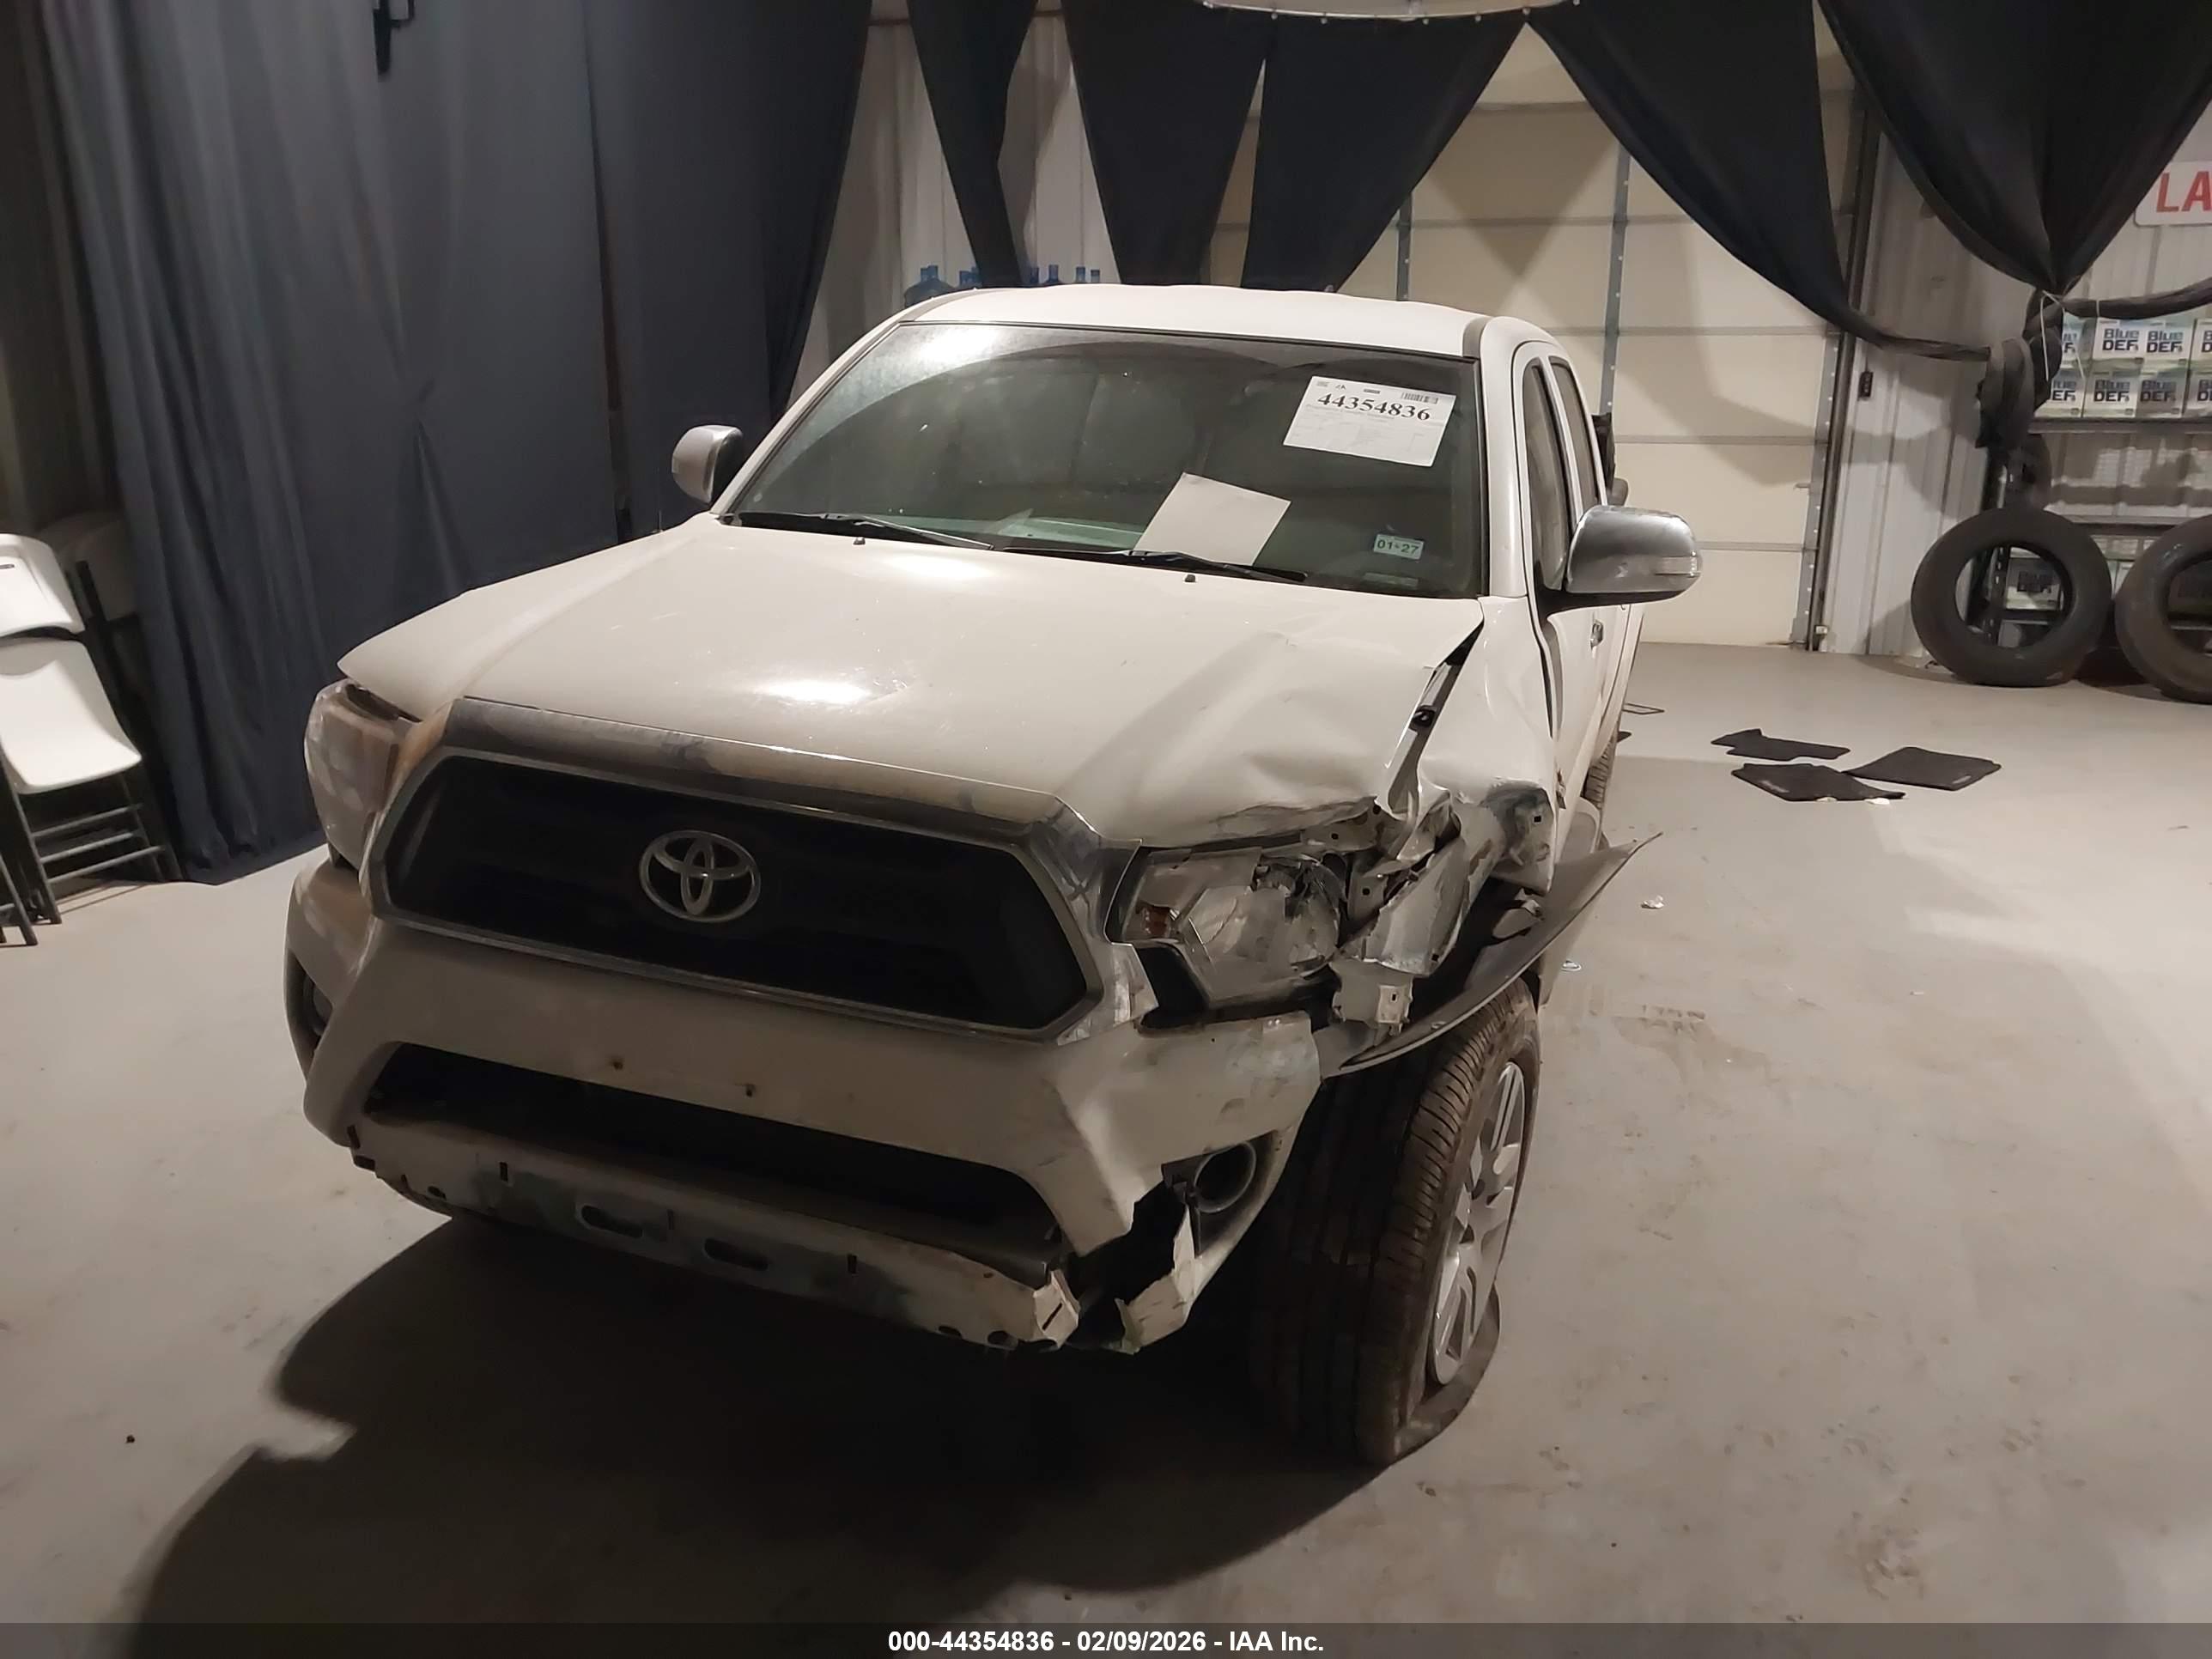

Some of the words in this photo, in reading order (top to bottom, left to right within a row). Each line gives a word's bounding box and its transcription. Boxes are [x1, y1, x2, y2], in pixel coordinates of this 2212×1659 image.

[2104, 328, 2139, 339] Blue
[2148, 331, 2183, 341] Blue
[2102, 339, 2137, 351] DEF
[2147, 342, 2182, 353] DEF
[1317, 392, 1431, 421] 44354836
[1376, 539, 1419, 556] 01-27
